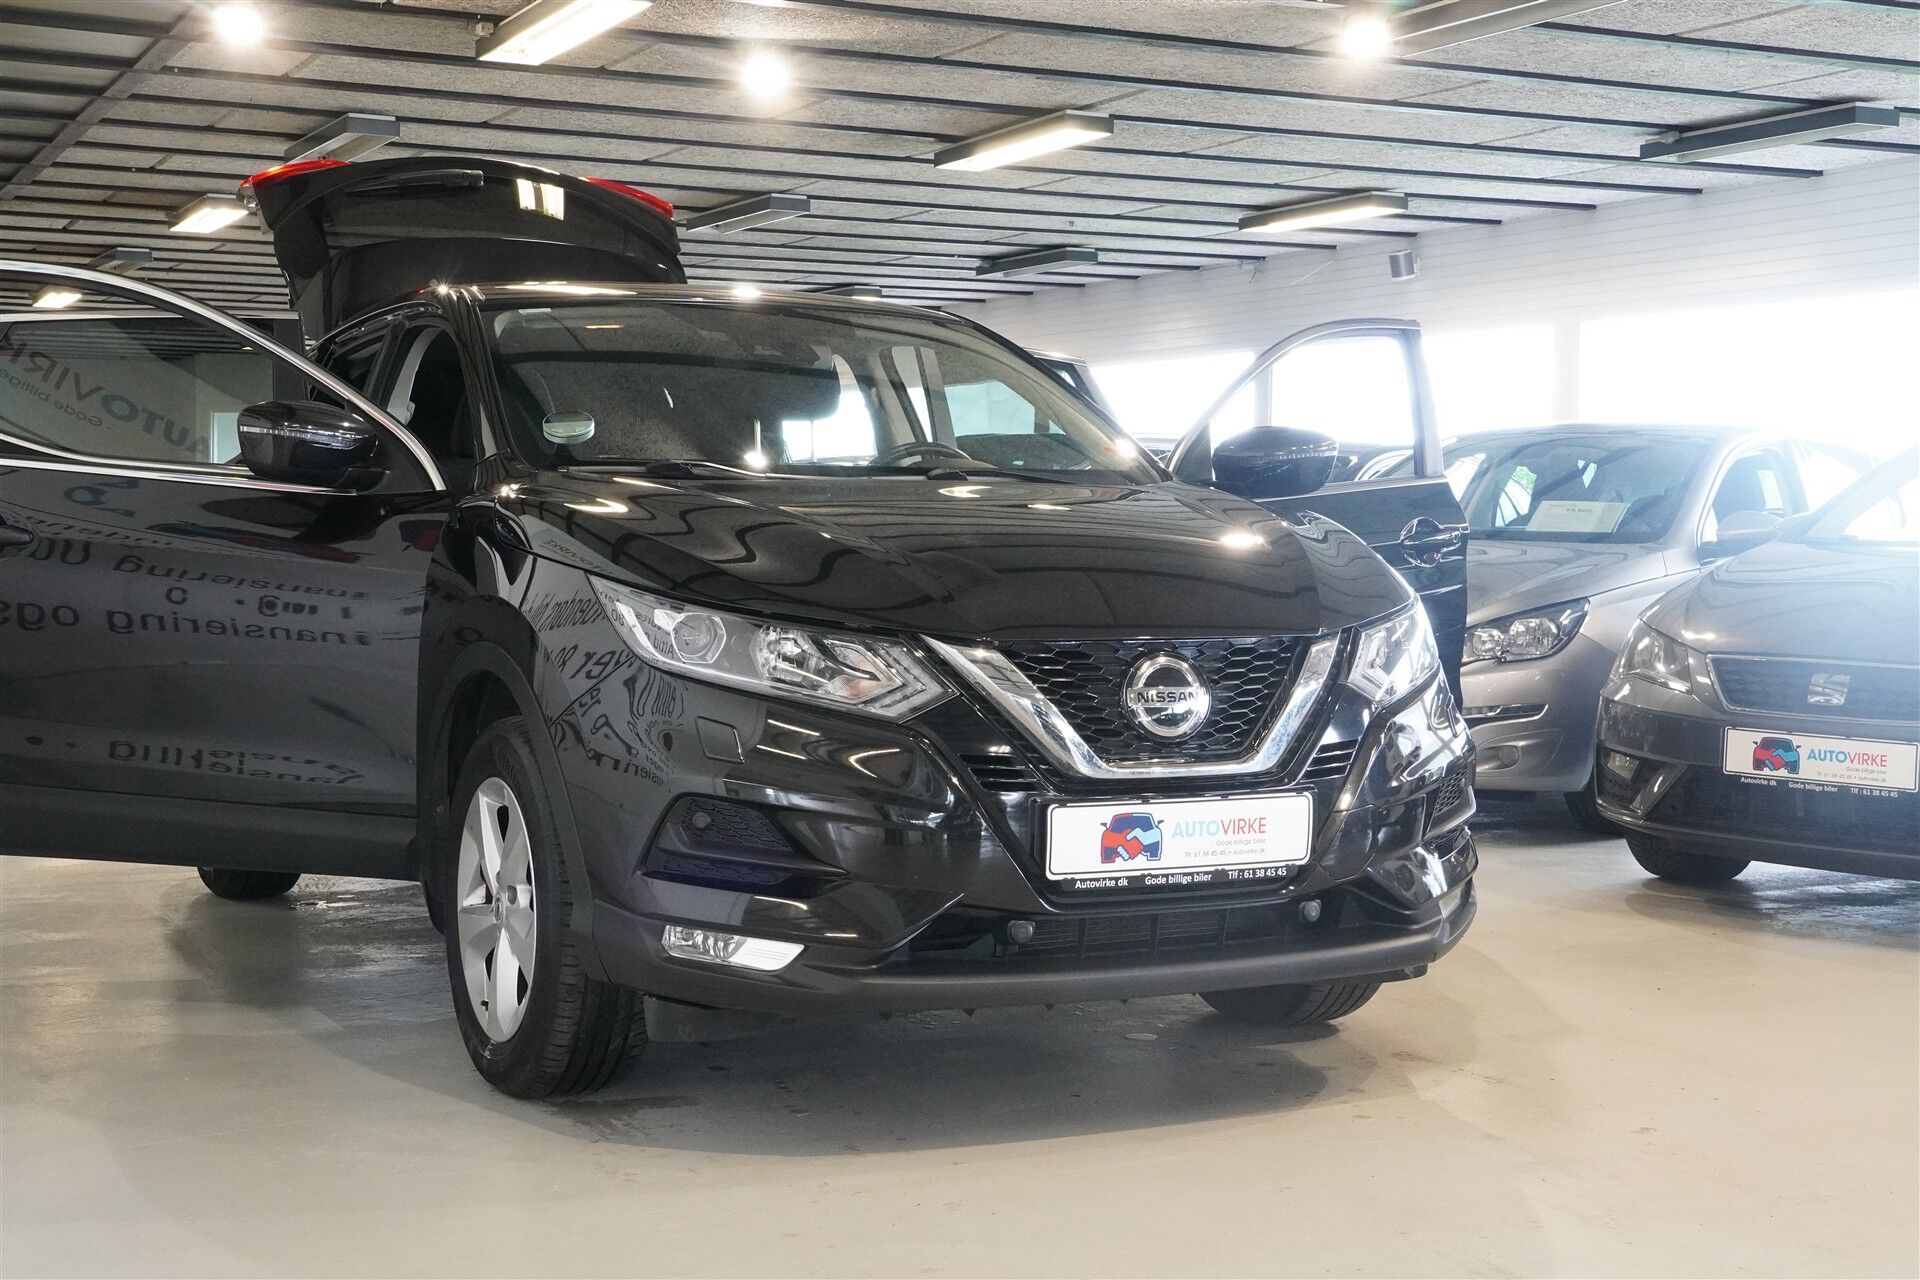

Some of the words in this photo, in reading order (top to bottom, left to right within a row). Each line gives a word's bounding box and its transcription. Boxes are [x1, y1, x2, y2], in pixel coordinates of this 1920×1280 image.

[1136, 691, 1199, 703] NISSAN
[1807, 748, 1888, 768] AUTOVIRKE
[1740, 776, 1769, 785] Autovirke
[1788, 781, 1804, 789] Gode
[1805, 783, 1823, 792] billige
[1171, 817, 1267, 839] AUTOVIRKE
[1075, 878, 1116, 889] Autovirke
[1117, 877, 1129, 886] dk
[1145, 875, 1166, 885] Gode
[1168, 874, 1192, 885] billige
[1193, 872, 1212, 882] biler
[1244, 870, 1254, 879] 61
[1255, 868, 1265, 878] 38
[1266, 868, 1276, 877] 45
[1277, 867, 1287, 876] 45
